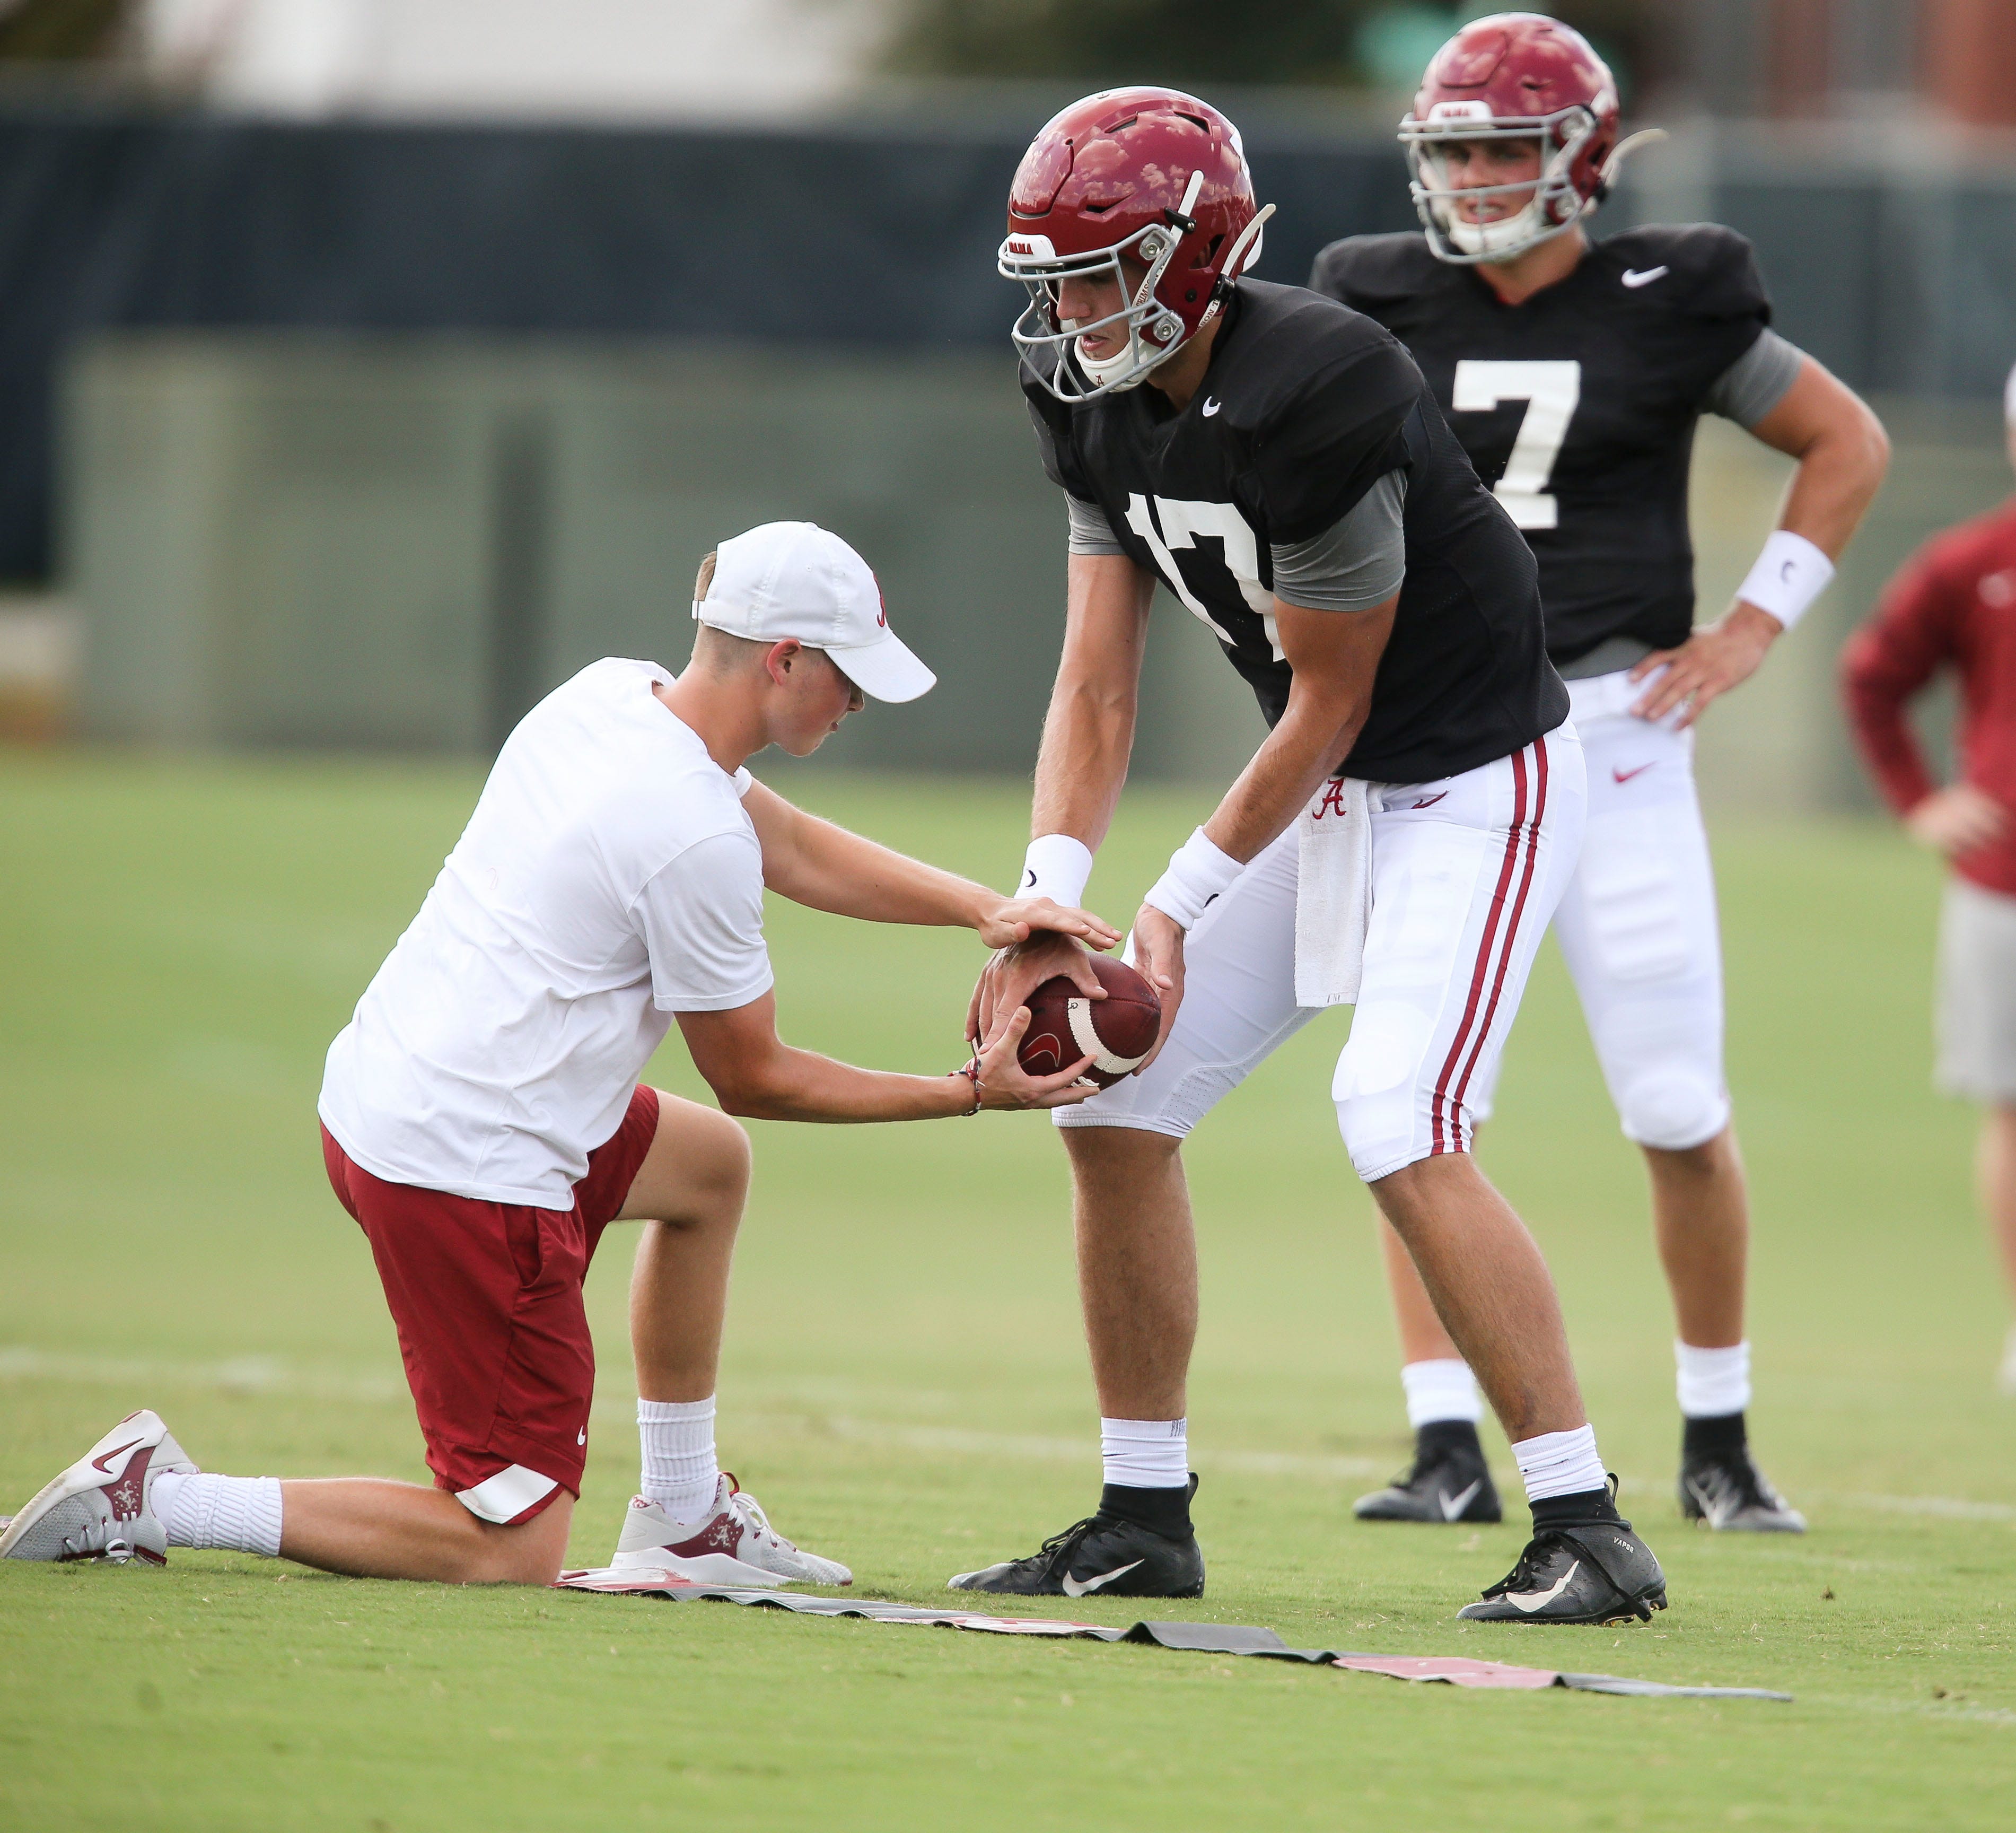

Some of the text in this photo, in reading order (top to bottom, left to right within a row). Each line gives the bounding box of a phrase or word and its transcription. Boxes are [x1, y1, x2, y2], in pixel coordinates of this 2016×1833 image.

[1452, 360, 1581, 529] 7
[1124, 492, 1285, 662] 17
[1312, 777, 1347, 819] A
[1614, 1537, 1634, 1553] VAPOR
